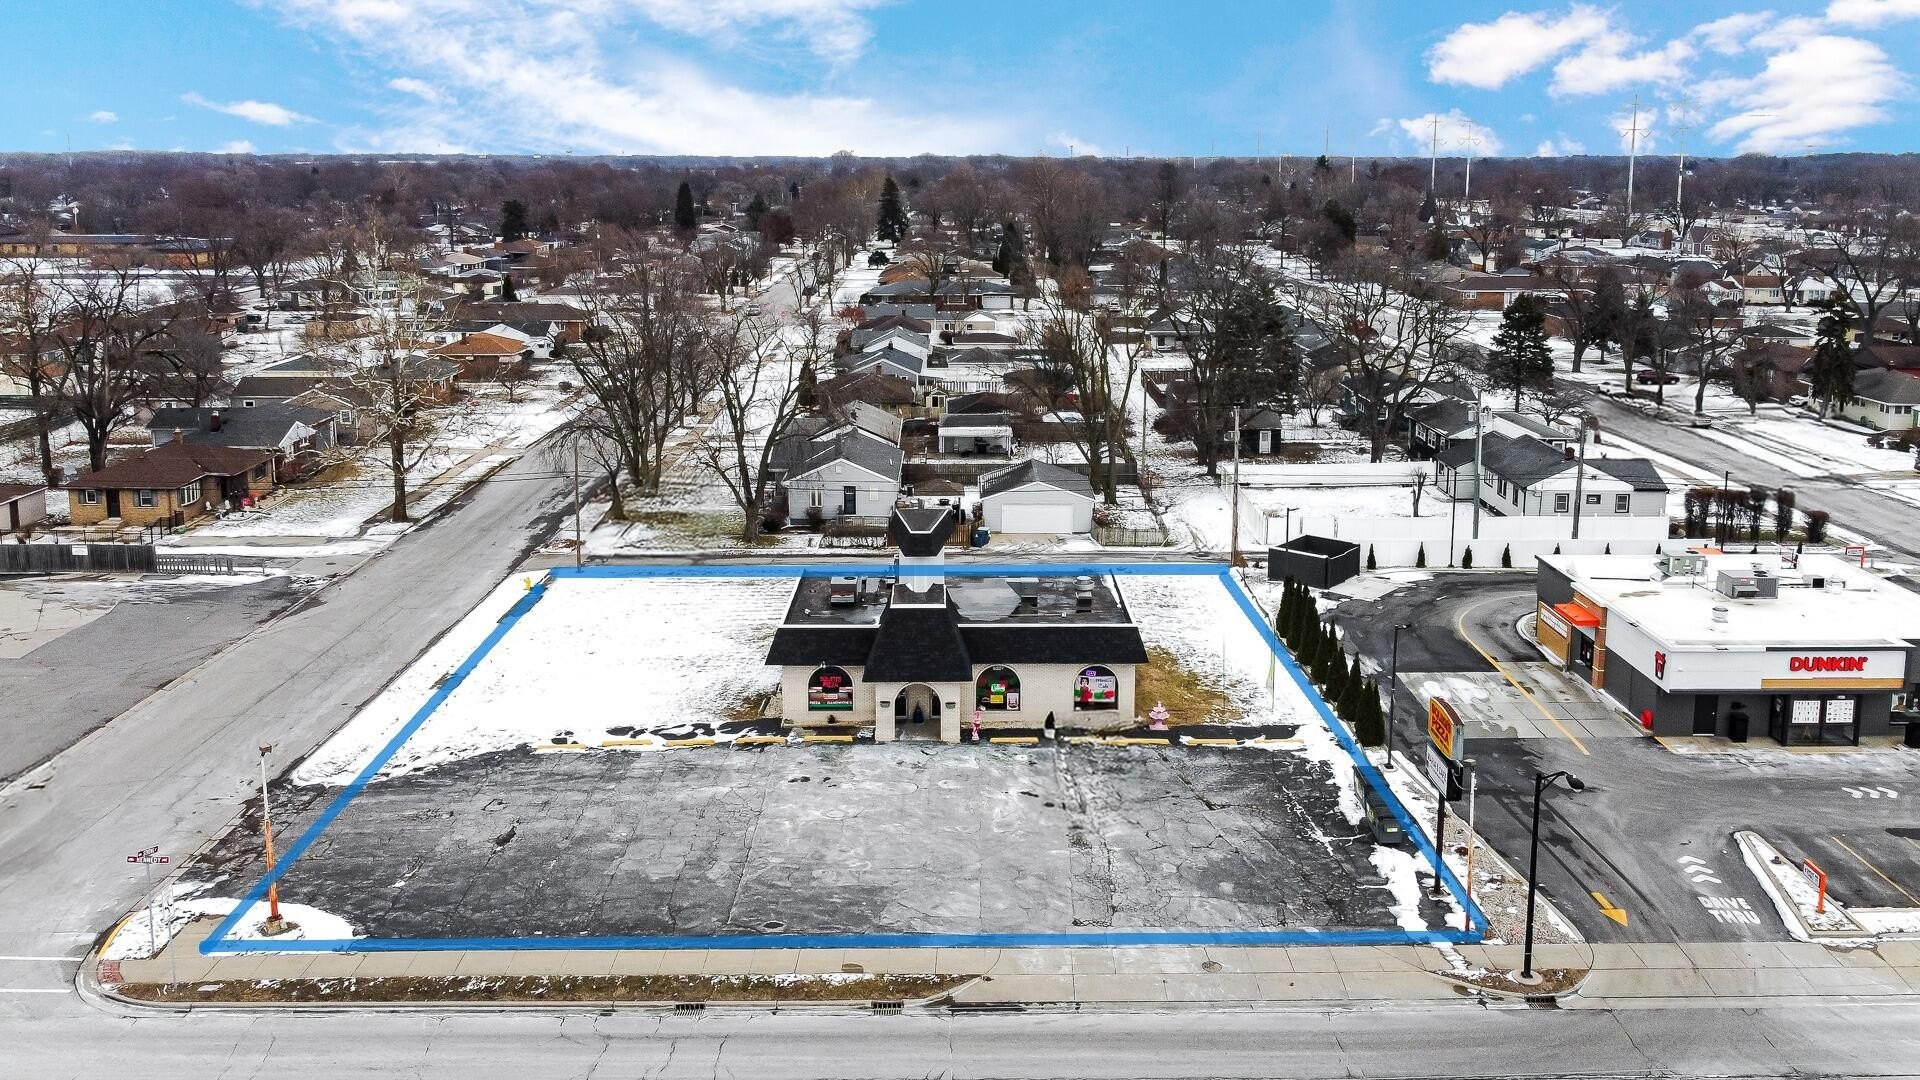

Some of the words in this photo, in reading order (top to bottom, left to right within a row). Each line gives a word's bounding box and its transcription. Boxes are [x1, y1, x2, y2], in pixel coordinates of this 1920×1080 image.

[1790, 656, 1868, 672] DUNKIN'
[1431, 715, 1450, 746] PIZZA
[1697, 896, 1752, 910] DRIVE
[1707, 909, 1761, 925] THRU
